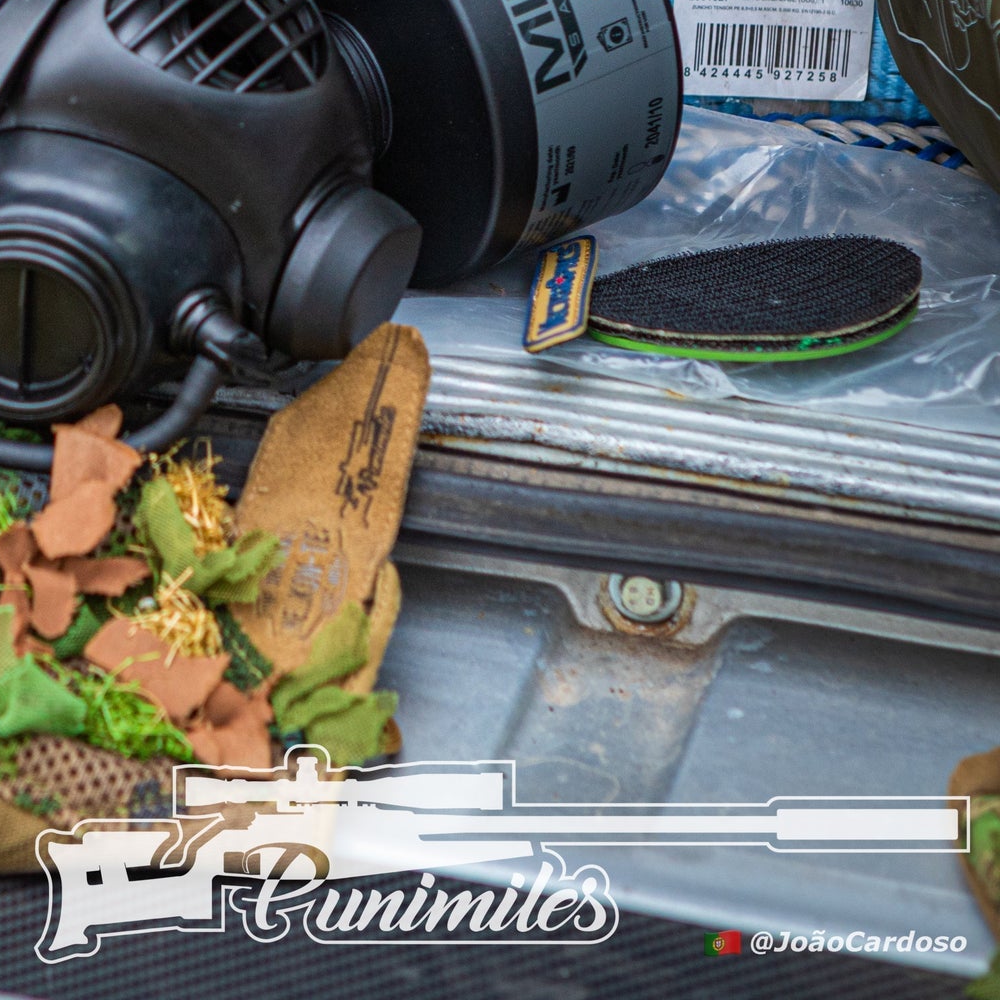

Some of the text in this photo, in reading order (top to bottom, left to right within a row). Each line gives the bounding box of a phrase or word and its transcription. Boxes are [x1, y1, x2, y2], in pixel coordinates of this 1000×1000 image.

[684, 67, 837, 83] 8 424445 927258
[645, 97, 663, 149] 2041/10
